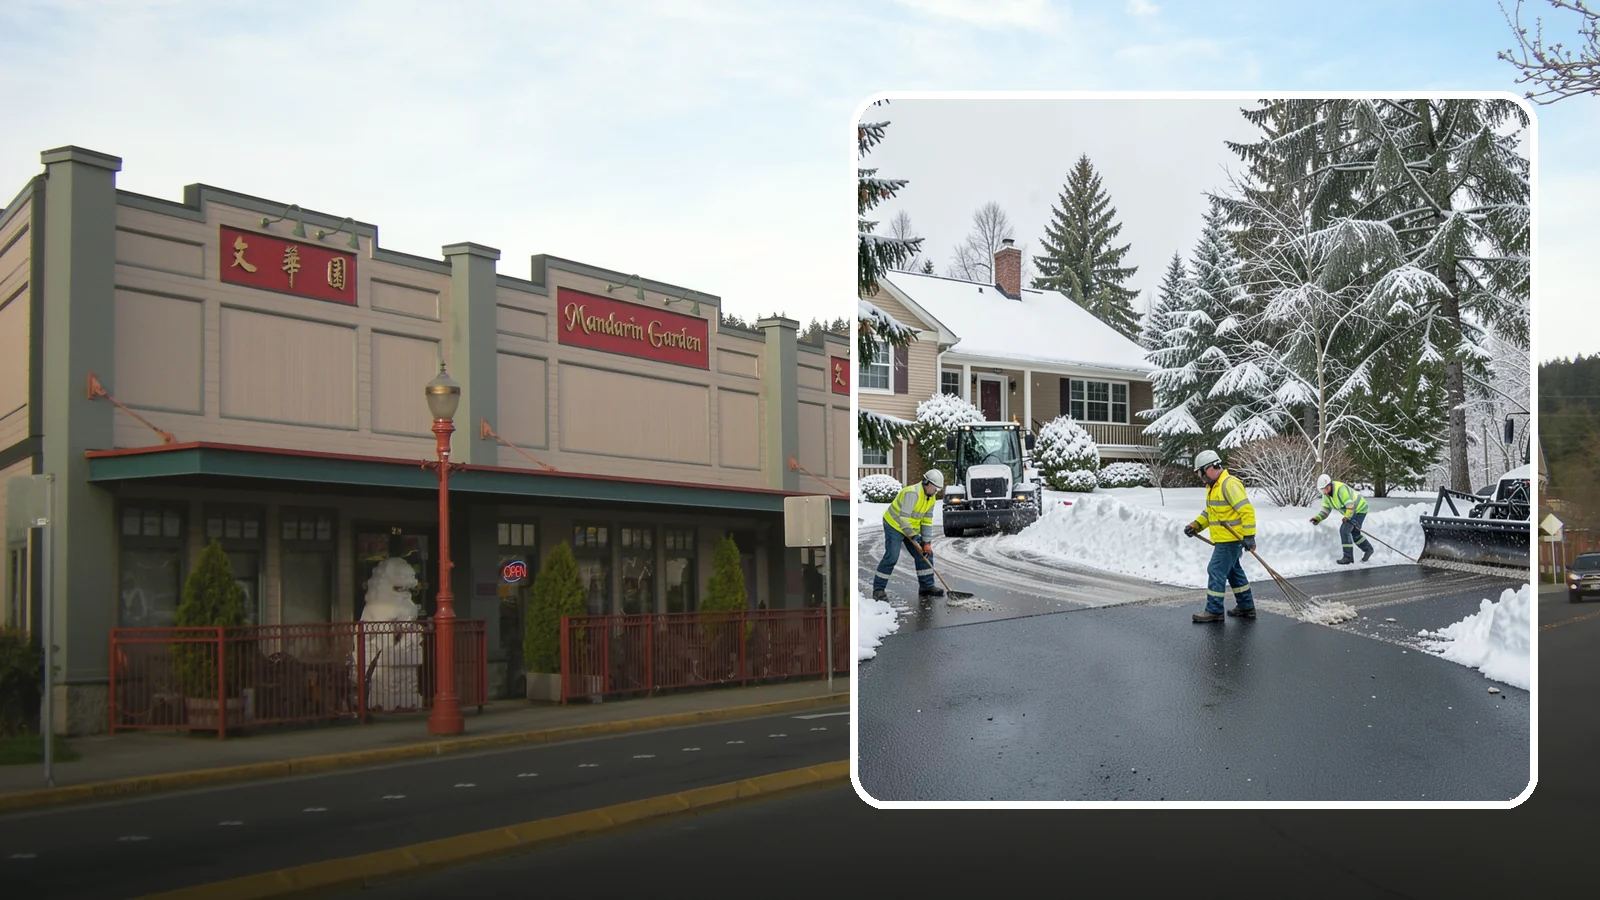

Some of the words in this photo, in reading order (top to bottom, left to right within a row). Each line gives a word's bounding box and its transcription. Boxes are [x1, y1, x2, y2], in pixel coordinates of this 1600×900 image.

[231, 236, 346, 291] 文華園
[564, 302, 644, 341] Mandarin
[648, 320, 702, 352] Garden
[503, 565, 527, 578] OPEN
